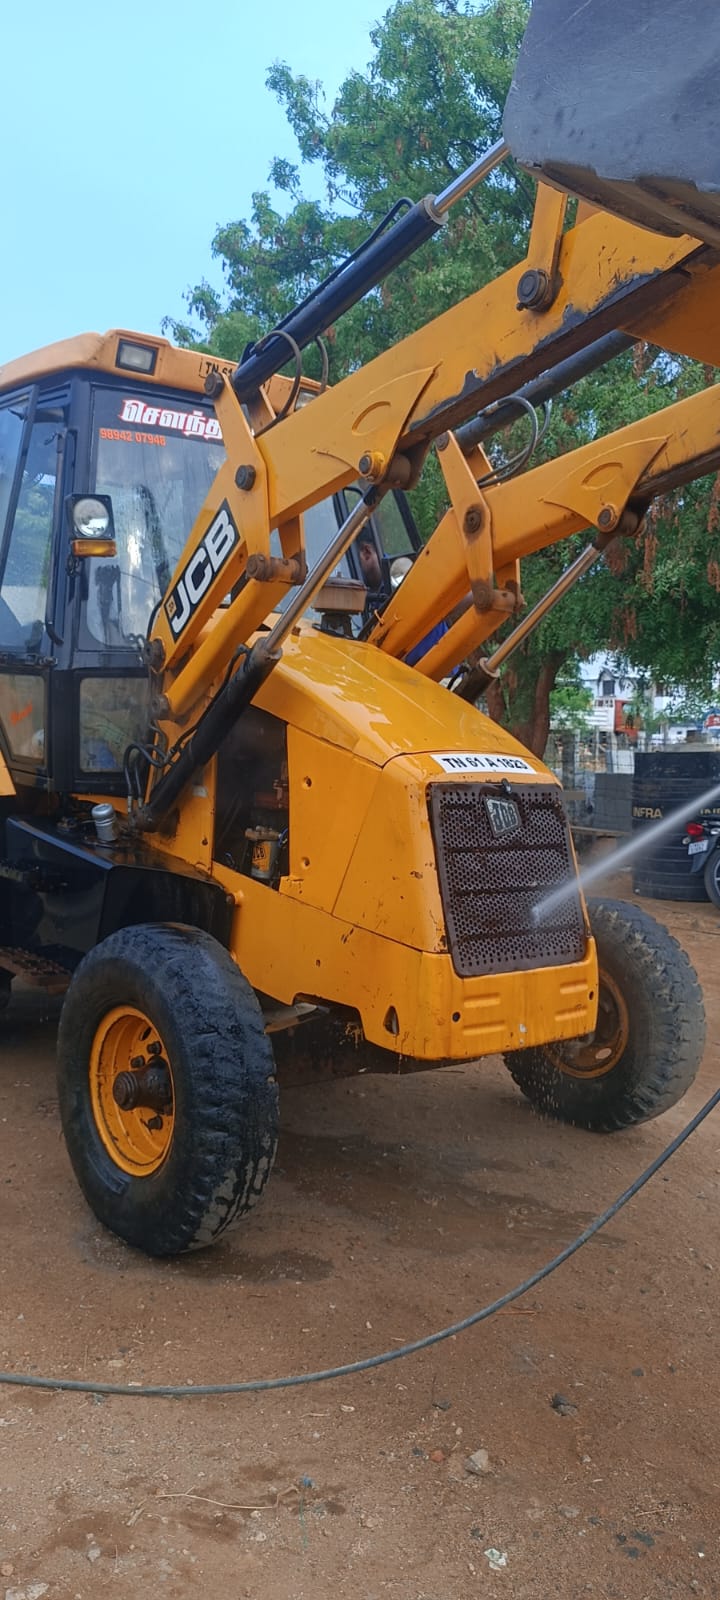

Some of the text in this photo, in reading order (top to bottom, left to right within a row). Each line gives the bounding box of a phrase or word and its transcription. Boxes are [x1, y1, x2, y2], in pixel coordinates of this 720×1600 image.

[205, 361, 219, 374] TN
[99, 428, 132, 442] 98942
[171, 509, 235, 633] JCB
[442, 758, 467, 768] TN
[465, 757, 485, 768] 61
[484, 757, 499, 768] A
[491, 801, 516, 830] JCB
